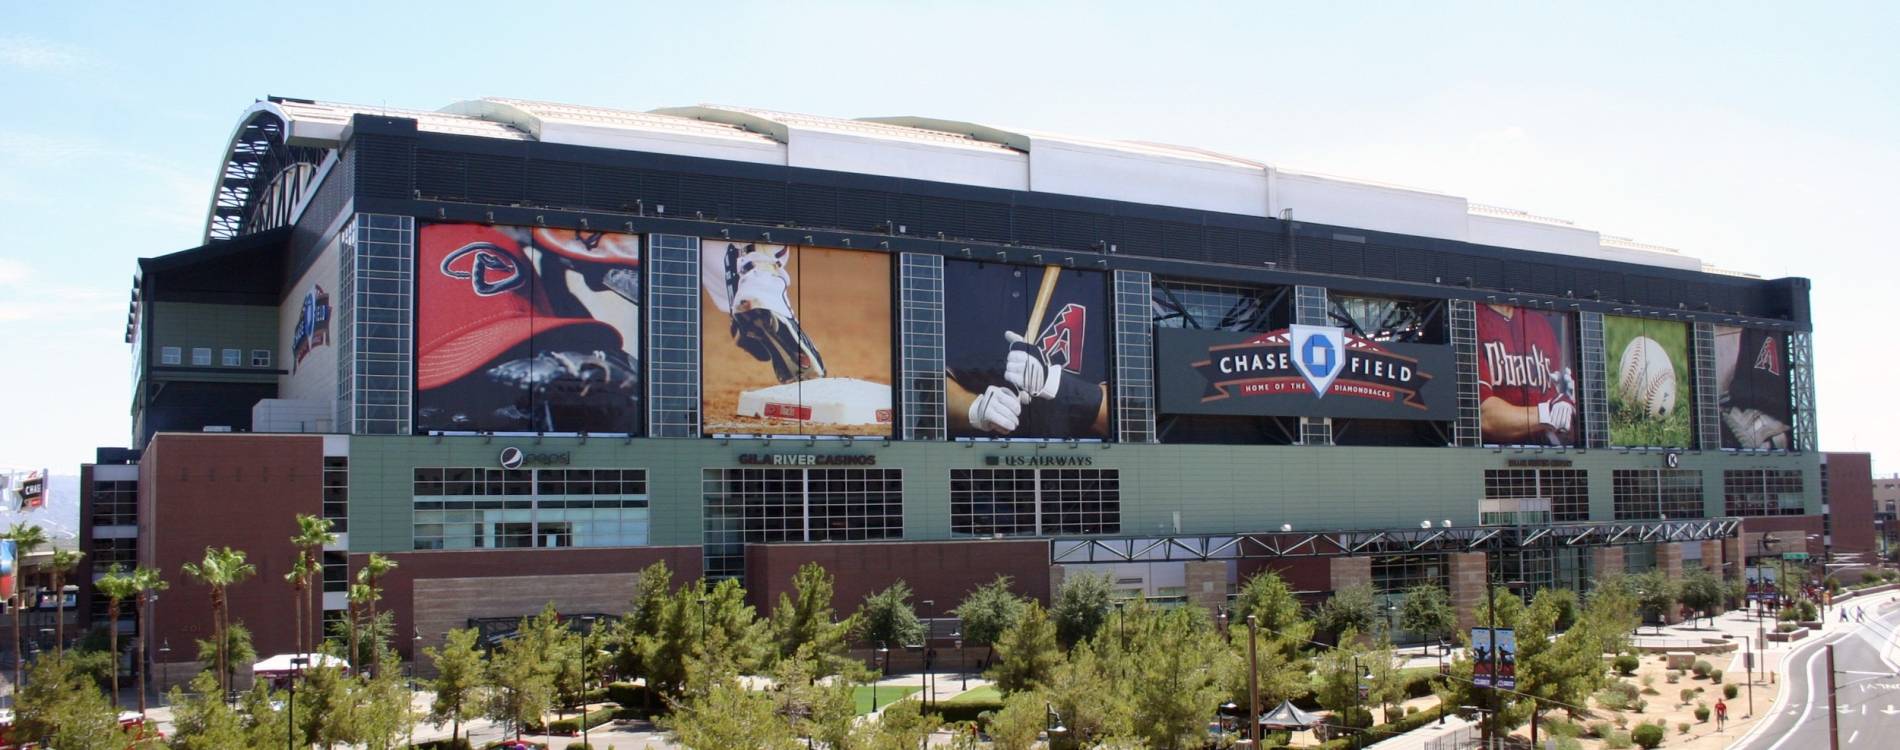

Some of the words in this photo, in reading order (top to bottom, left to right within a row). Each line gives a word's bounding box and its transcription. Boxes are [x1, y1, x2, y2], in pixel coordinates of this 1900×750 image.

[1219, 353, 1289, 374] CHASE
[1351, 357, 1412, 382] FIELD
[1245, 384, 1270, 393] HOME
[1274, 383, 1286, 391] OF
[1291, 382, 1307, 390] THE
[1334, 384, 1391, 398] DIAMONDBACKS
[1029, 456, 1092, 466] AIRWAYS
